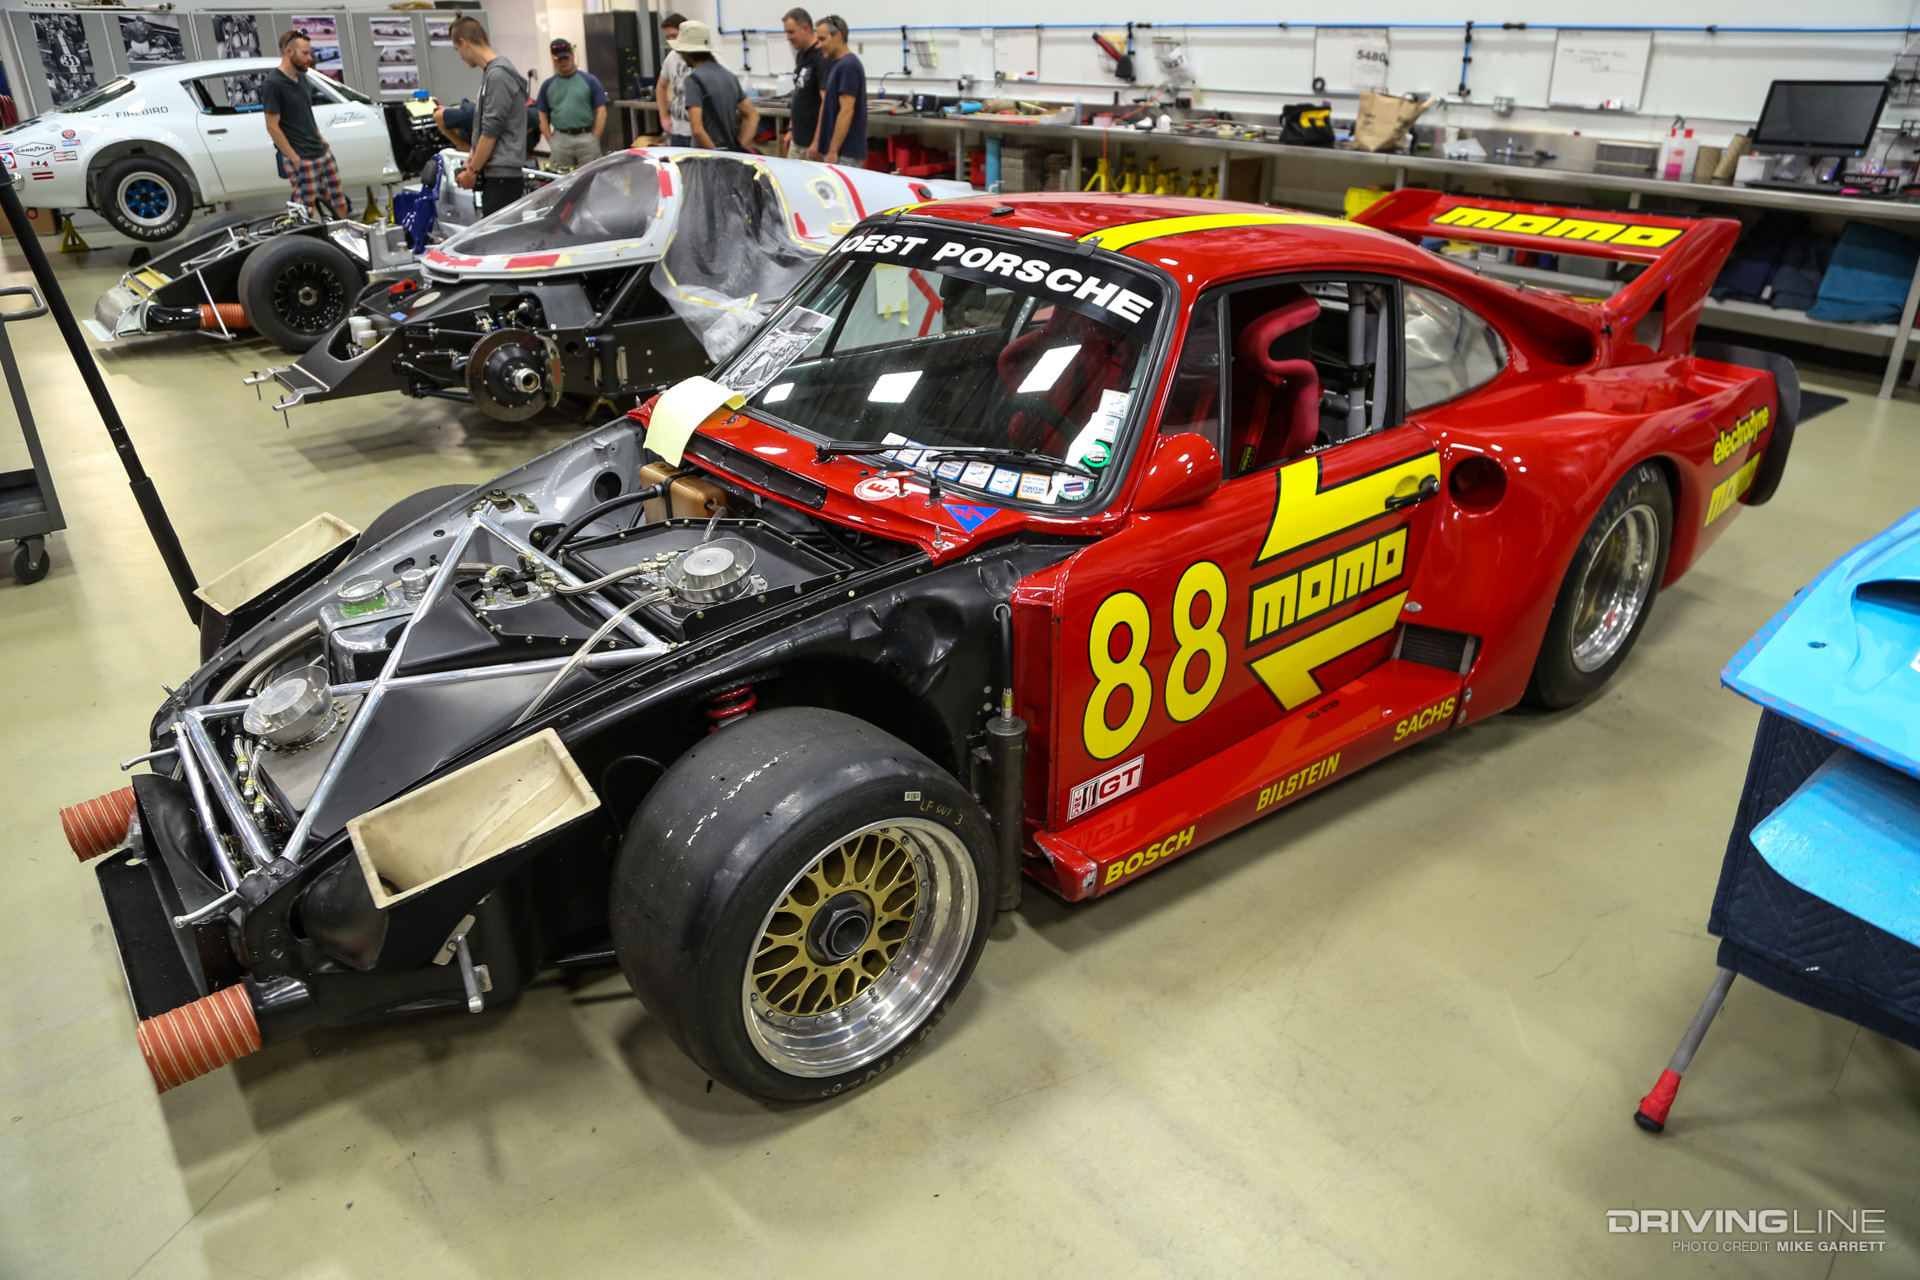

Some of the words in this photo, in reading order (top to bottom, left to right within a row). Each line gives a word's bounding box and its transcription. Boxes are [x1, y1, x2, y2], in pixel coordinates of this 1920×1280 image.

[1357, 50, 1386, 62] 5480
[931, 242, 1153, 324] PORSCHE
[1713, 405, 1770, 466] electrodyne
[1083, 560, 1228, 760] 88
[1393, 697, 1456, 742] SACHS
[1099, 763, 1141, 799] GT
[1256, 752, 1341, 812] BILSTEIN
[1104, 825, 1196, 886] BOSCH
